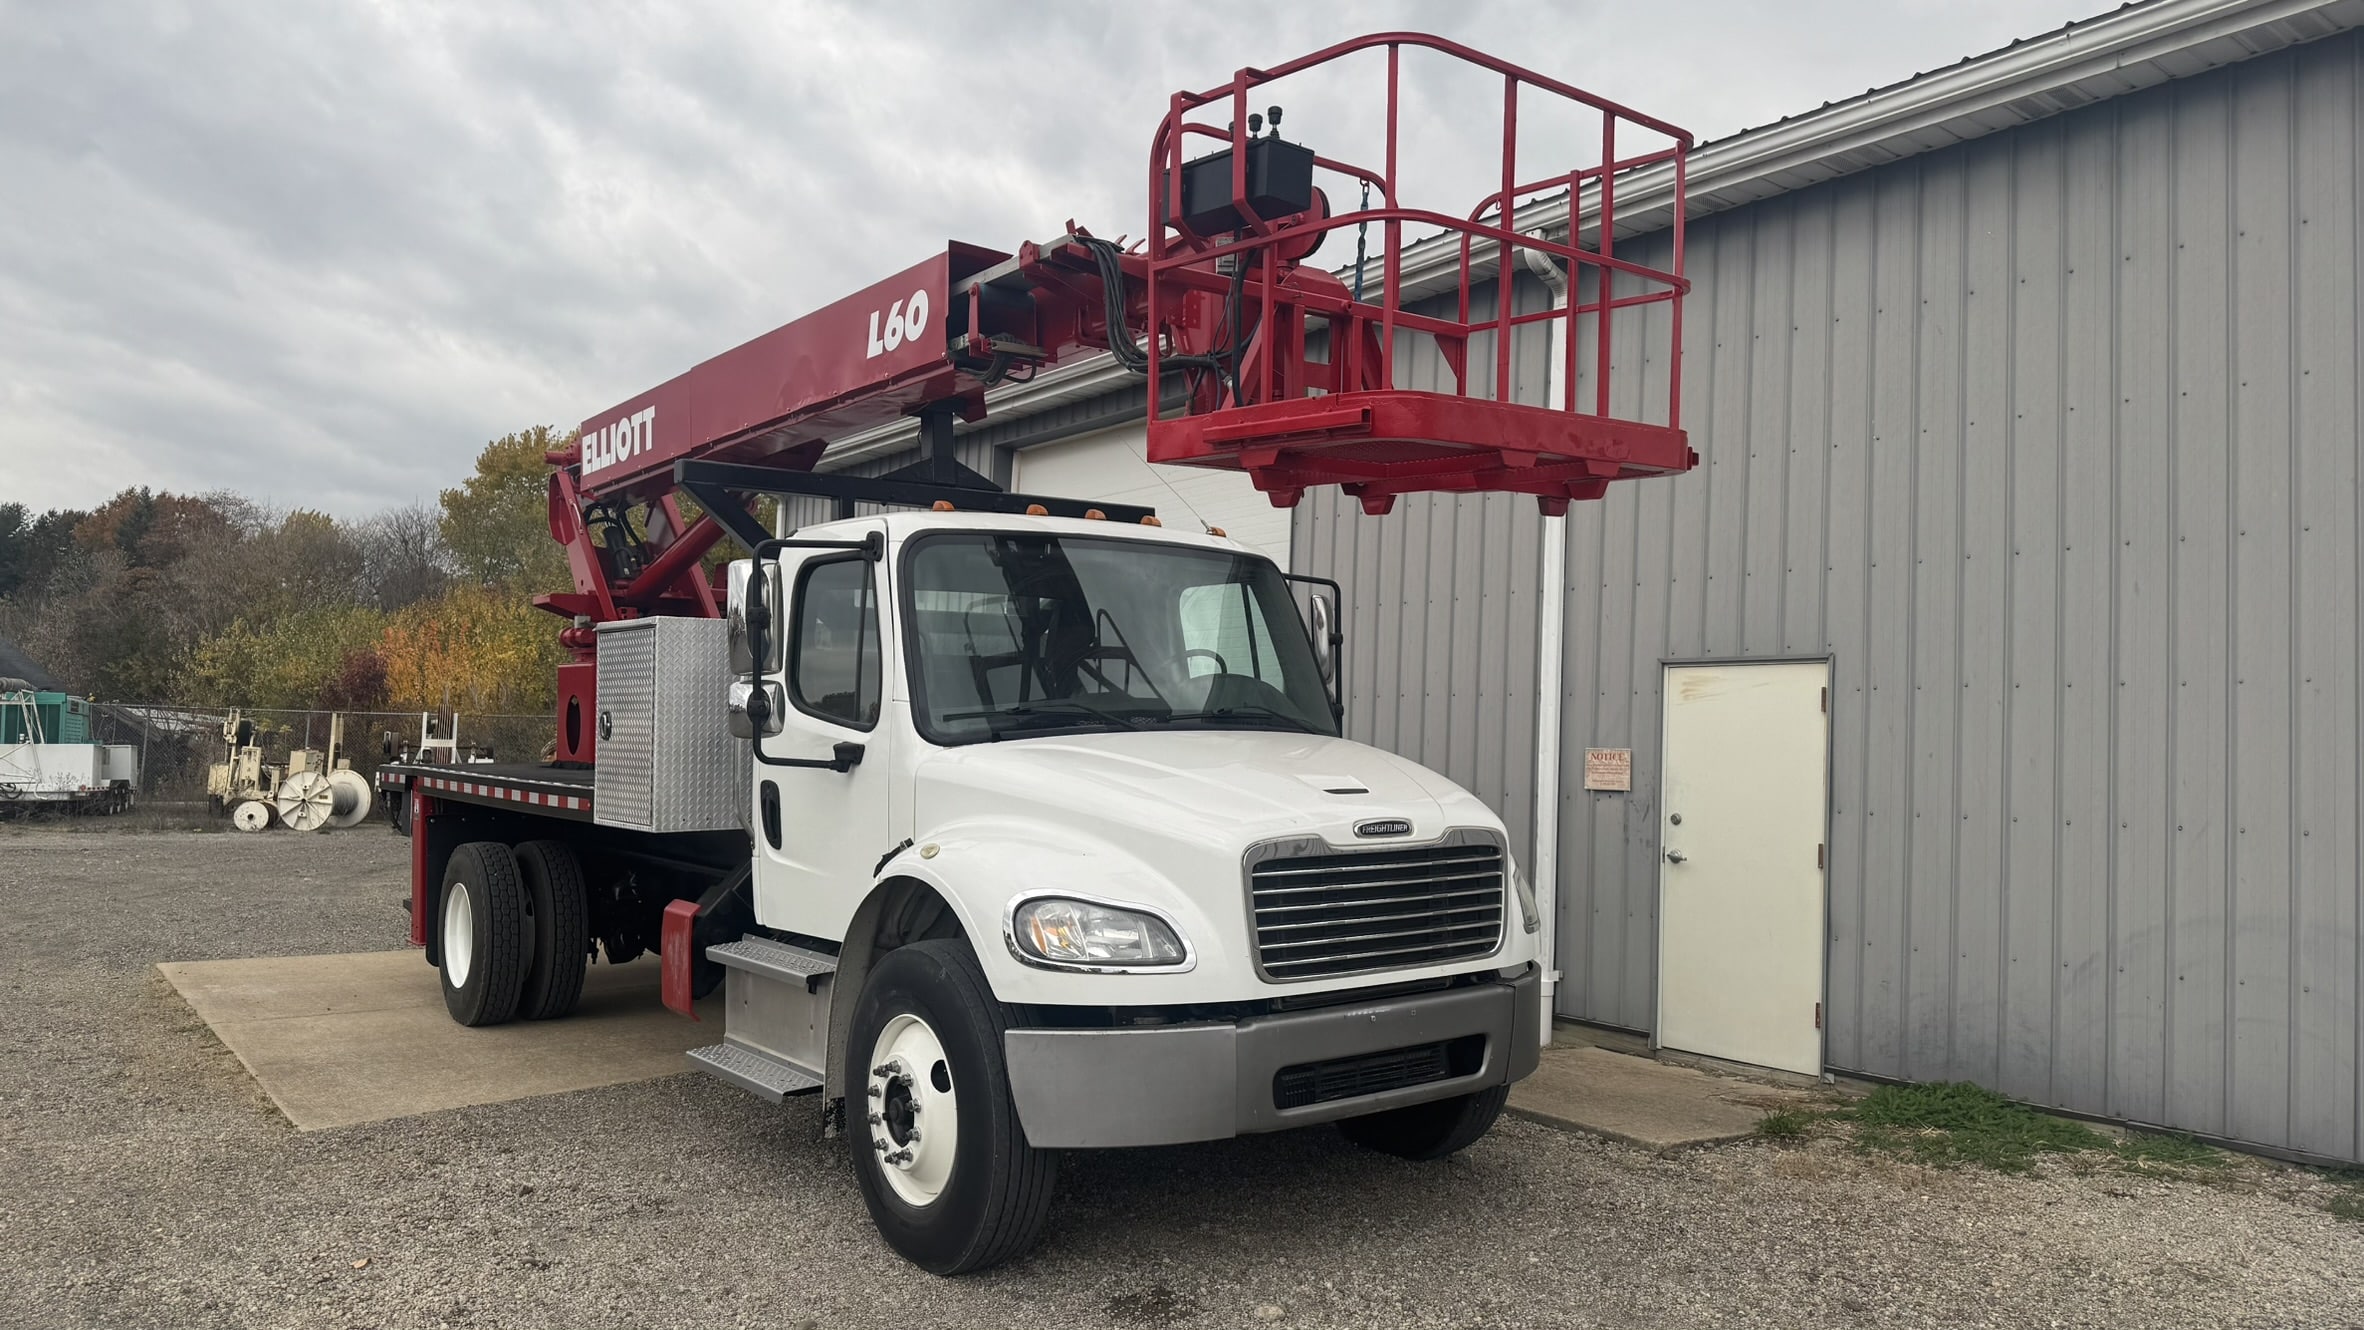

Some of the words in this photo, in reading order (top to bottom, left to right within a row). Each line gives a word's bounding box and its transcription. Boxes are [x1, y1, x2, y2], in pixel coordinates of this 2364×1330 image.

[866, 289, 929, 359] L60
[582, 405, 656, 476] ELLIOTT
[1591, 752, 1625, 761] NOTICE
[1362, 823, 1408, 834] FREIGHTLINER
